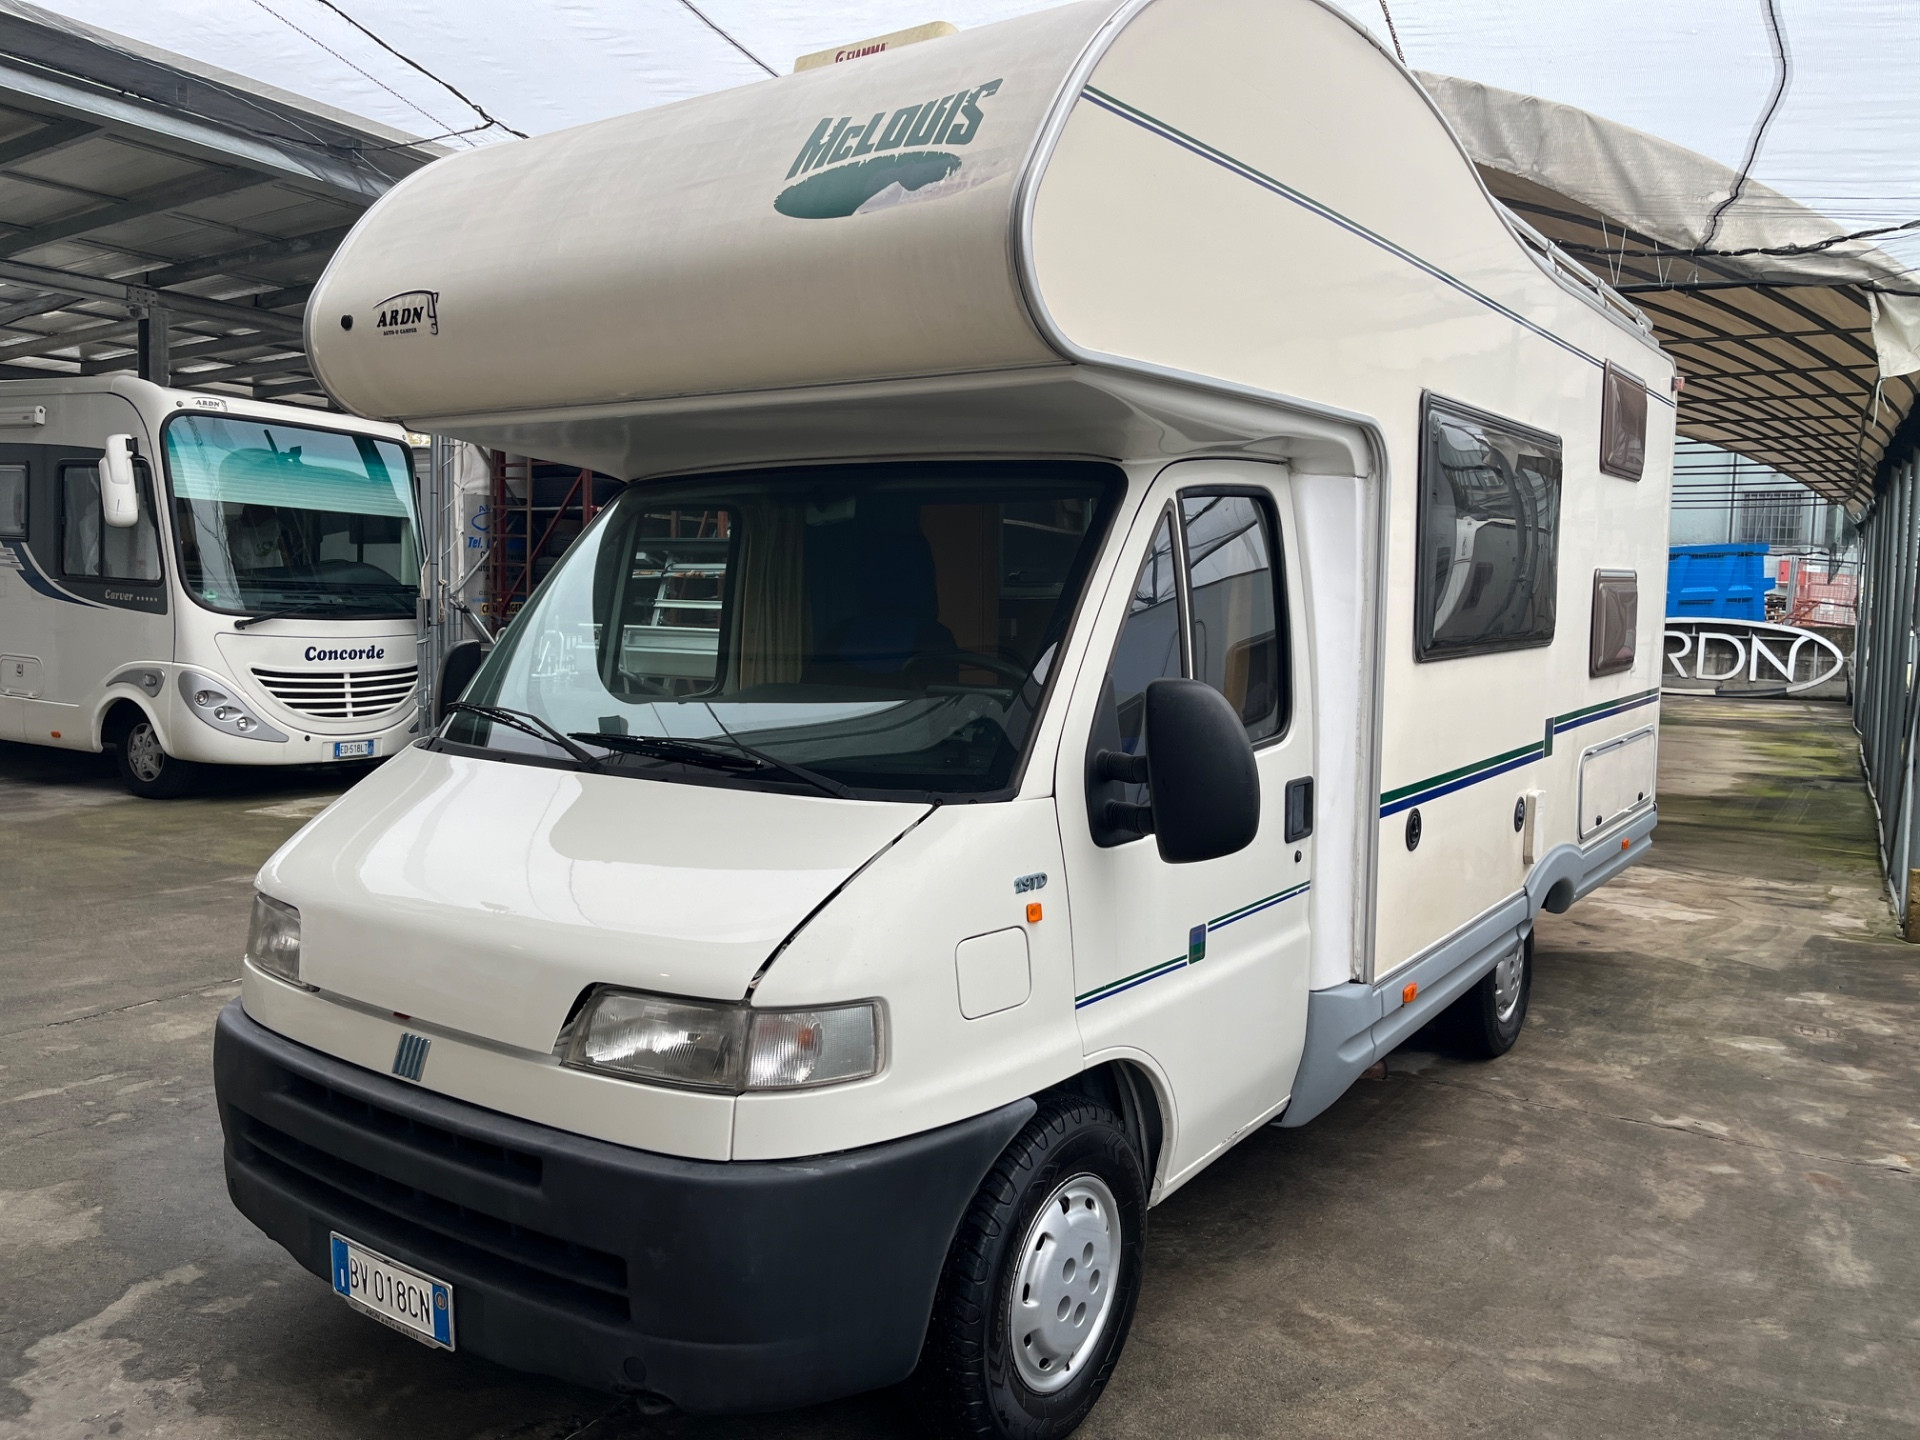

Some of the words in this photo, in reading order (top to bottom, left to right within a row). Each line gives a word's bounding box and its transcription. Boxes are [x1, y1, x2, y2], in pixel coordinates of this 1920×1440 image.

[377, 306, 424, 328] ARDN
[104, 588, 134, 601] Carver
[304, 644, 385, 662] Concorde
[1663, 630, 1812, 683] RDN
